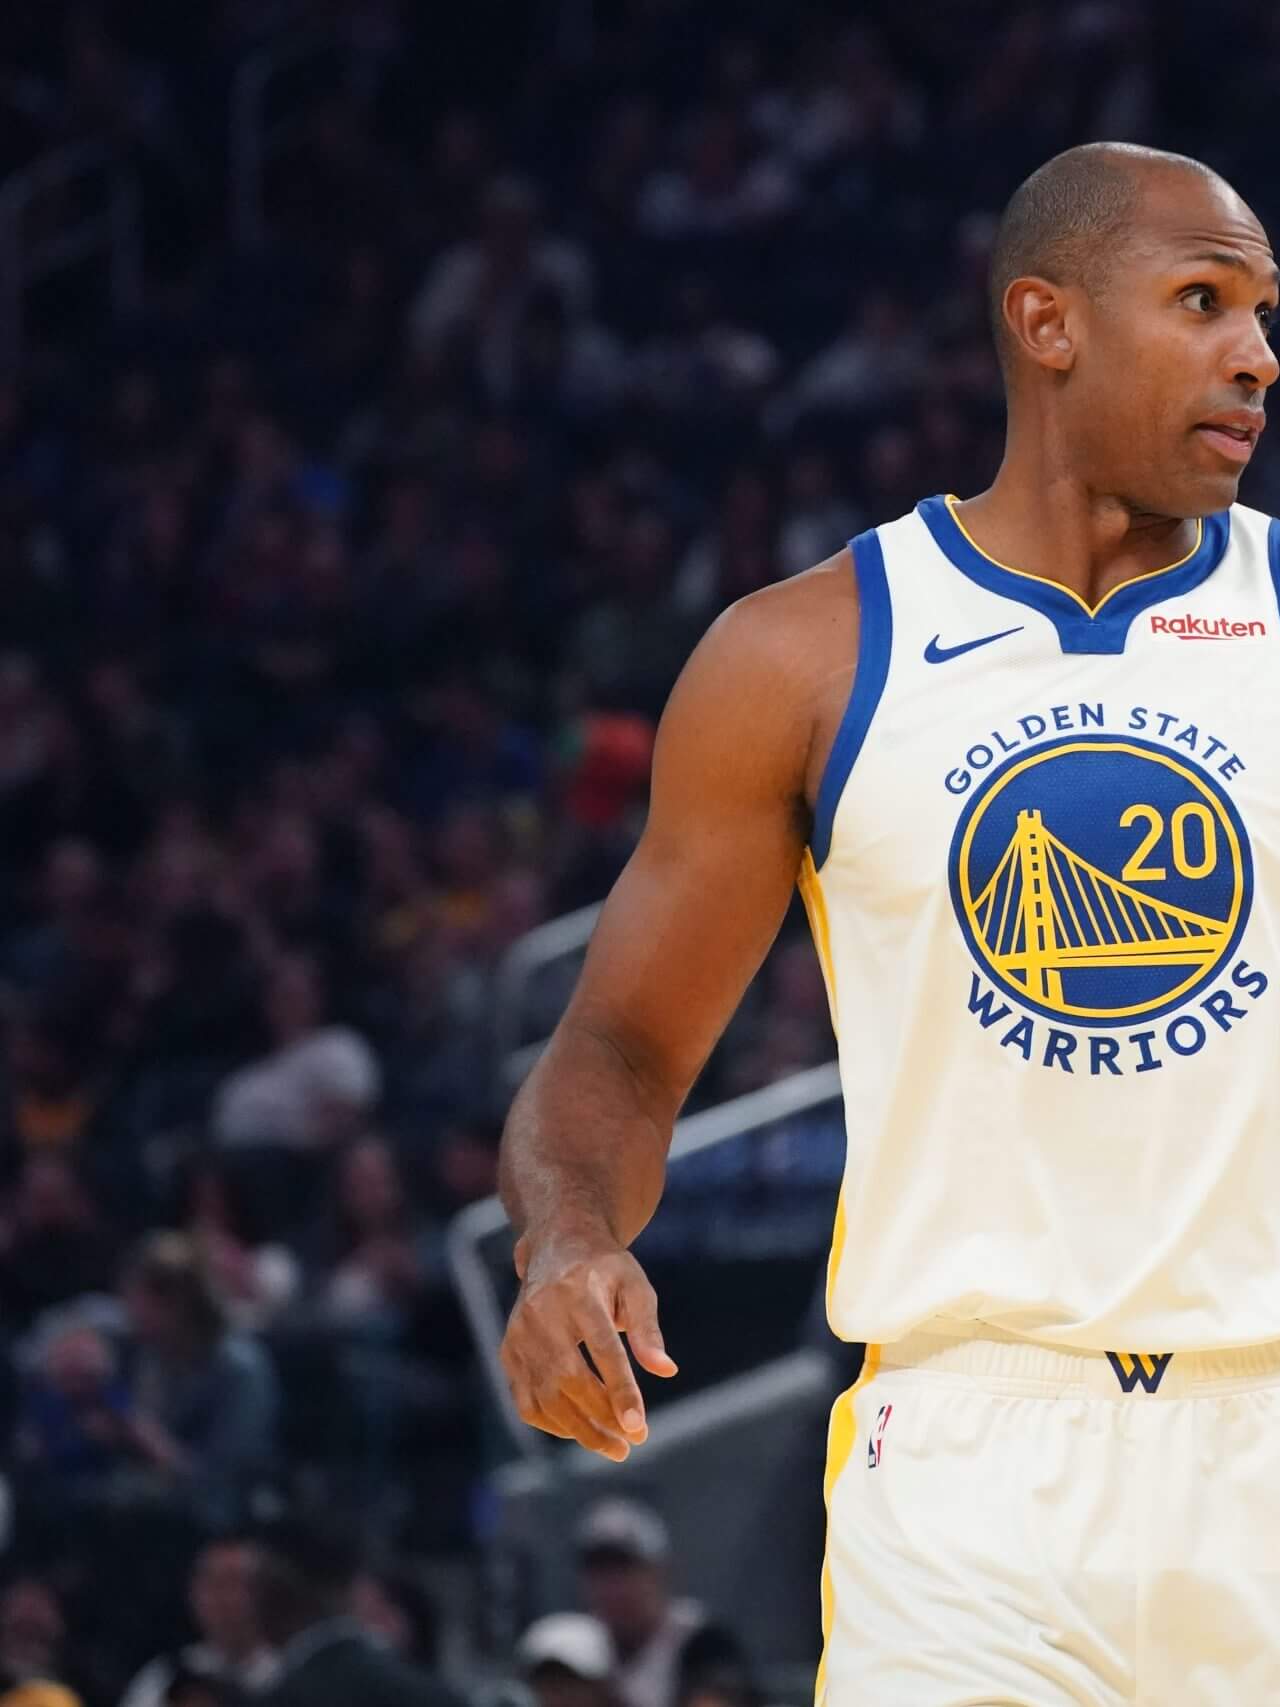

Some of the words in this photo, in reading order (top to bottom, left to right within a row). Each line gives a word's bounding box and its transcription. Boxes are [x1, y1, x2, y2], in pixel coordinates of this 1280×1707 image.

[1150, 613, 1266, 639] Rakuten
[944, 702, 1106, 795] GOLDEN
[1128, 706, 1246, 782] STATE
[1119, 801, 1218, 882] 20
[967, 959, 1269, 1076] WARRIORS
